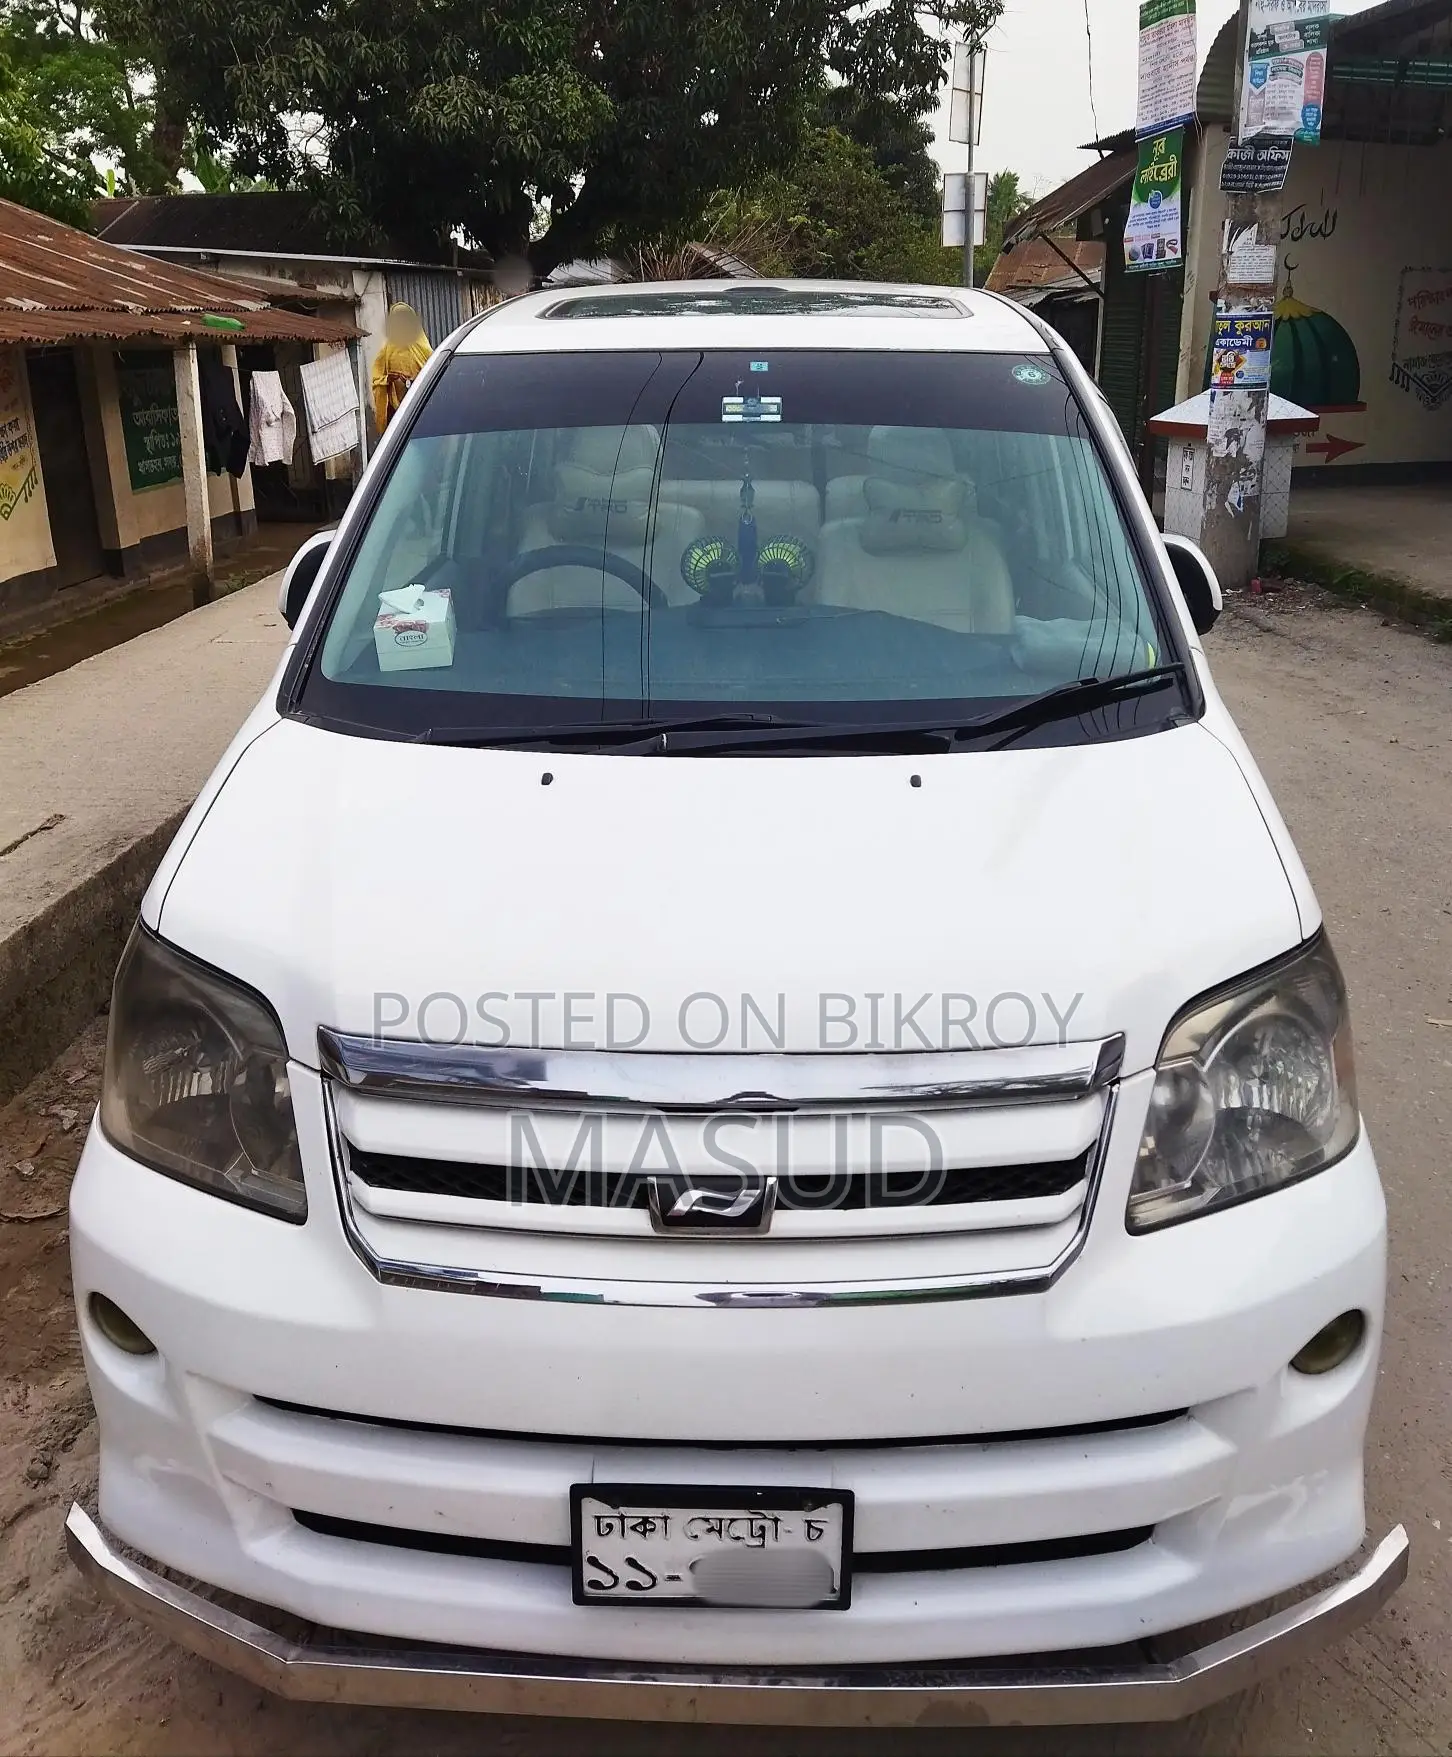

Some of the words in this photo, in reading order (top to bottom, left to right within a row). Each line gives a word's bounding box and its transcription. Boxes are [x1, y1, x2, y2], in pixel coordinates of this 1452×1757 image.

[1152, 136, 1167, 161] নূর
[1227, 145, 1256, 161] কাজী
[1256, 145, 1292, 161] অফিস
[1140, 154, 1178, 184] লাইব্রেরী
[1215, 320, 1231, 337] তুল
[1234, 319, 1271, 336] কুরআন
[593, 1511, 671, 1540] ঢাকা
[803, 1516, 829, 1542] চ
